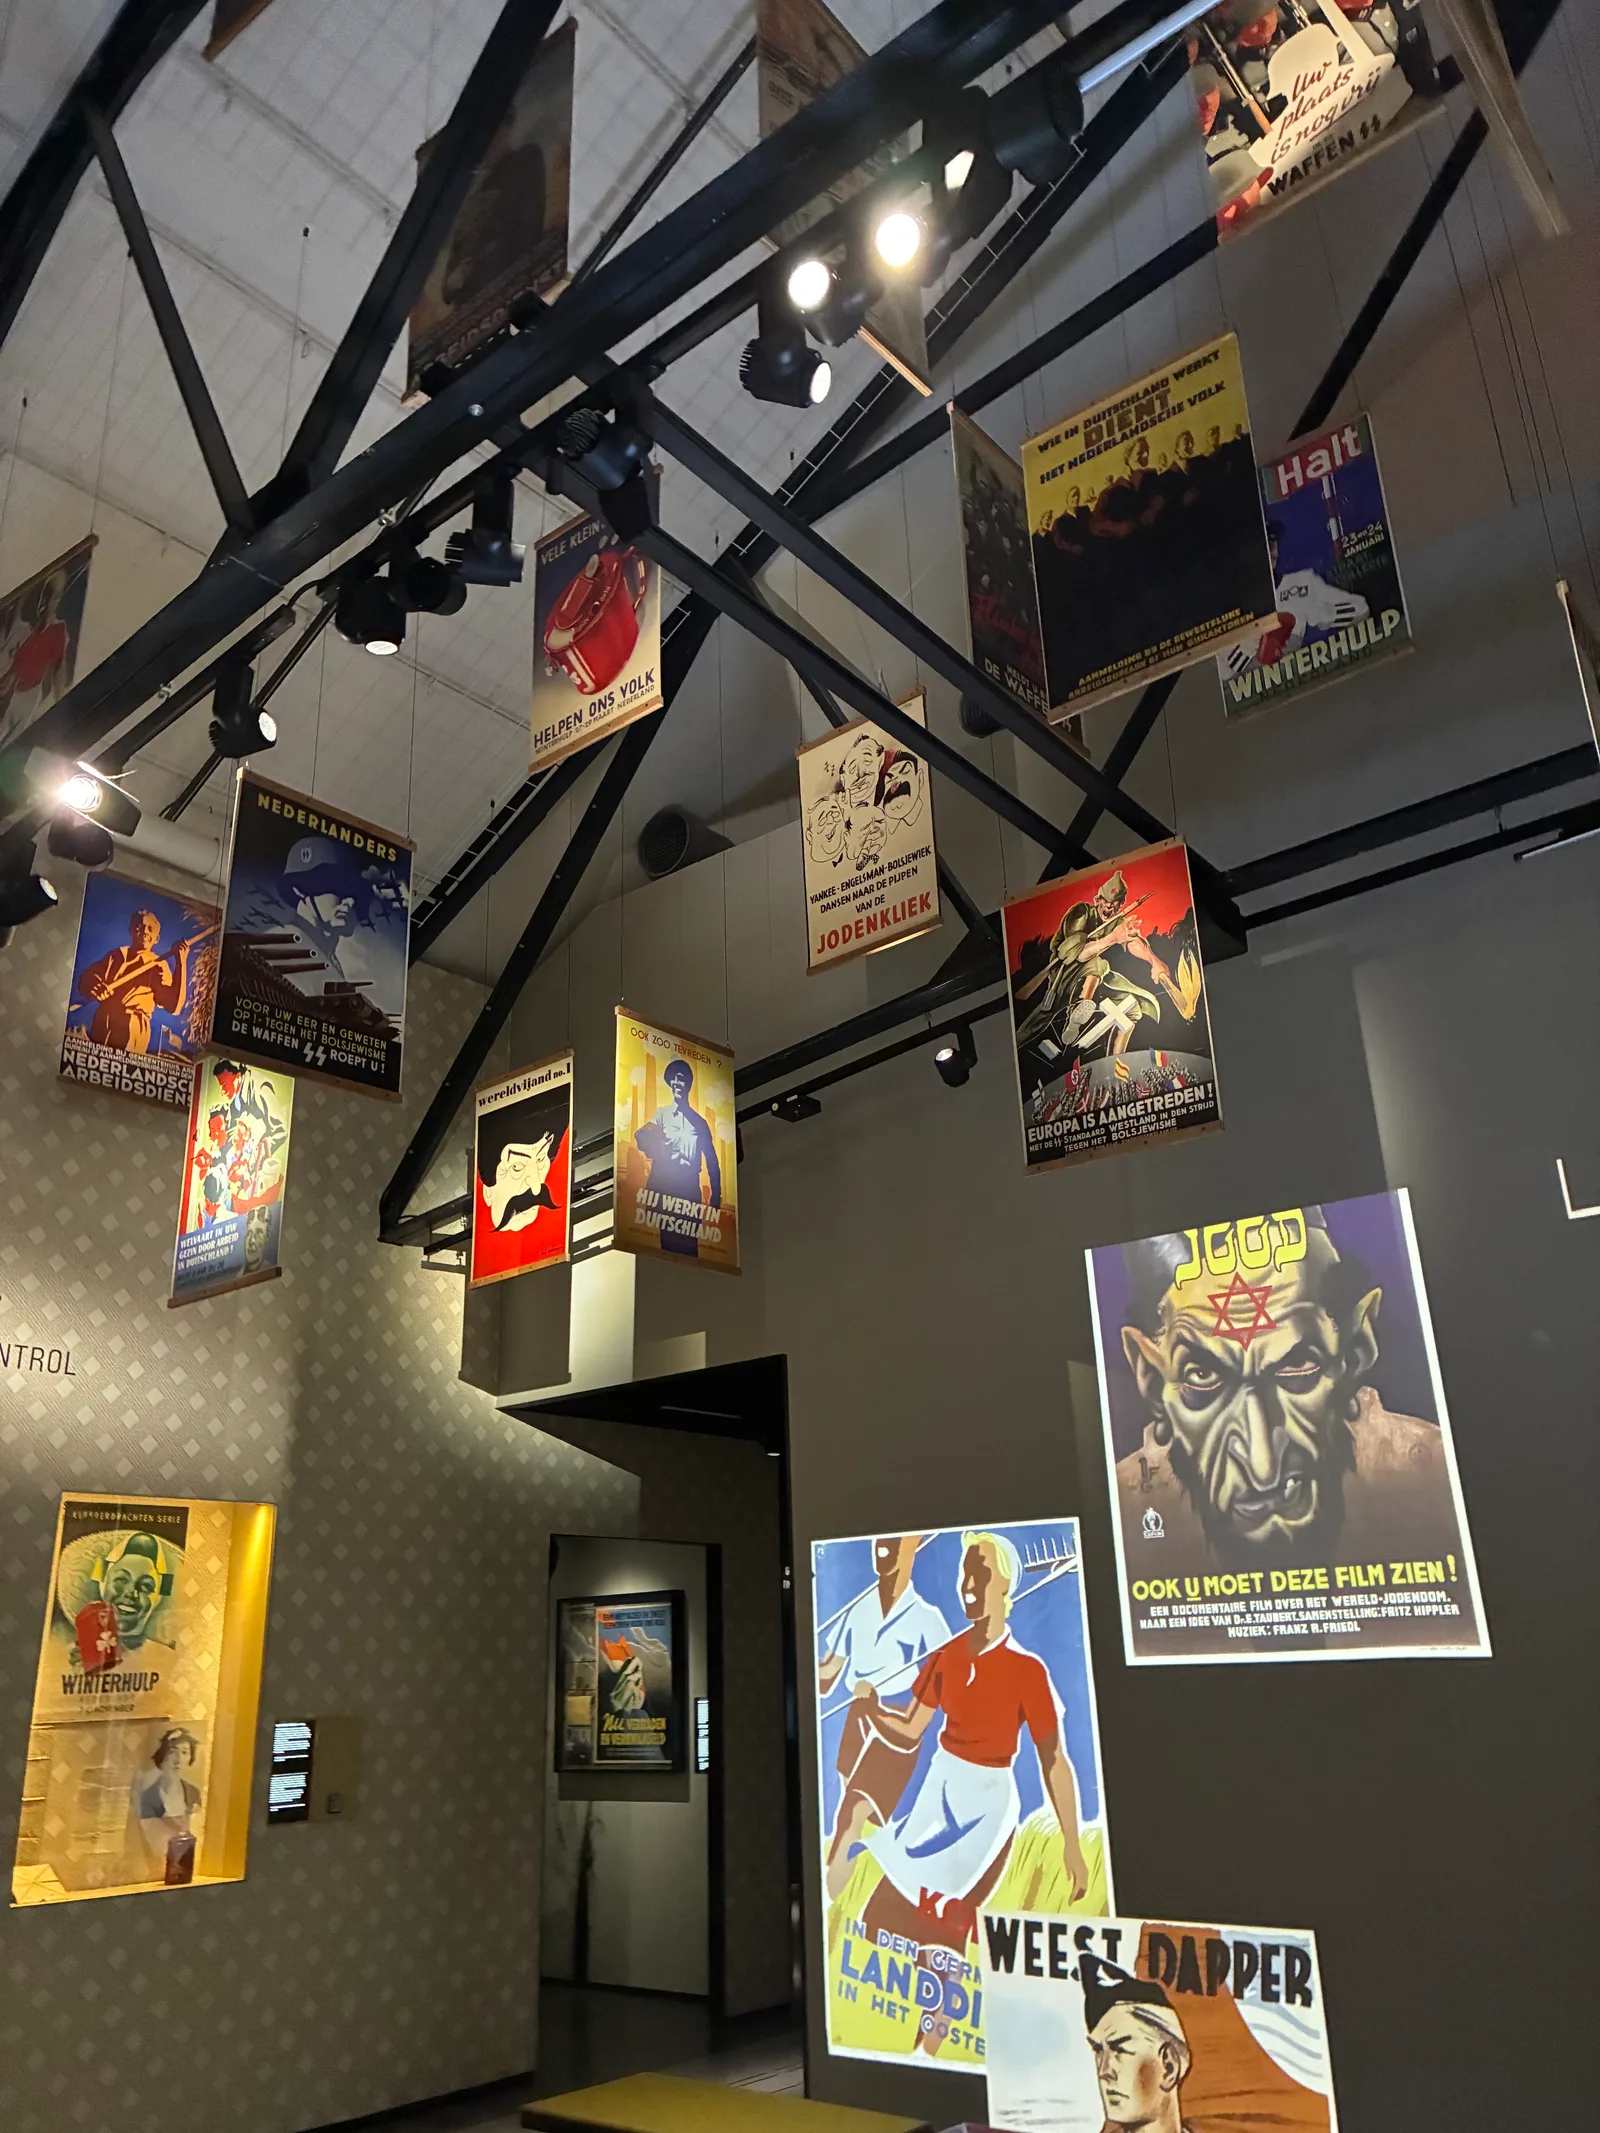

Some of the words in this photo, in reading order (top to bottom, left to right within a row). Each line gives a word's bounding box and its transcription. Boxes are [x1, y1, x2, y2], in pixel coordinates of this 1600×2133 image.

[1278, 67, 1354, 140] plaats
[1271, 141, 1290, 165] is
[1295, 109, 1336, 147] nog
[1267, 136, 1355, 196] WAFFEN
[1037, 433, 1062, 454] WIE
[1064, 424, 1079, 441] IN
[1083, 376, 1170, 428] DUITSCHLAND
[1172, 349, 1220, 382] WERKT
[1083, 388, 1171, 450] DIENT
[1039, 463, 1066, 485] HET
[1067, 400, 1186, 473] NEDERLANDSCHE
[1187, 380, 1226, 408] VOLK
[1276, 423, 1363, 495] Halt
[541, 539, 567, 567] VELE
[569, 520, 606, 550] KLEIN
[1341, 532, 1358, 548] 23
[1367, 520, 1384, 536] 24
[1344, 530, 1385, 558] JANUARI
[1078, 651, 1143, 687] AANMELDING
[1159, 638, 1172, 650] DE
[1228, 608, 1401, 702] WINTERHULP
[533, 709, 583, 748] HELPEN
[589, 691, 615, 718] ONS
[619, 668, 655, 699] VOLK
[984, 657, 1002, 681] DE
[1004, 671, 1050, 717] WAFFE
[535, 730, 573, 755] WINTERHULP
[593, 707, 615, 723] MAART
[617, 685, 655, 710] NEDERLAND
[257, 792, 397, 862] NEDERLANDERS
[820, 893, 851, 914] DANSEN
[852, 884, 875, 901] NAAR
[876, 878, 887, 891] DE
[889, 865, 918, 886] PIJPEN
[855, 899, 873, 914] VAN
[874, 894, 886, 907] DE
[816, 891, 932, 955] JODENKLIEK
[232, 1019, 249, 1035] DE
[252, 1025, 300, 1050] WAFFEN
[329, 1049, 366, 1071] ROEPT
[235, 996, 269, 1016] VOOR
[275, 1009, 291, 1022] UW
[297, 1015, 317, 1030] EER
[321, 1023, 335, 1035] EN
[339, 1028, 387, 1050] GEWETEN
[265, 1019, 296, 1035] TEGEN
[300, 1029, 317, 1041] HET
[321, 1034, 386, 1061] BOLSJEWISME
[65, 1036, 114, 1053] AANMELDING
[115, 1049, 127, 1059] BIJ
[630, 1027, 649, 1041] OOK
[652, 1035, 671, 1050] ZOO
[673, 1043, 712, 1066] TEVREDEN
[63, 1049, 192, 1093] NEDERLANDSC
[478, 1069, 552, 1107] wereldvijand
[1027, 1118, 1081, 1143] EUROPA
[1082, 1112, 1096, 1131] IS
[1029, 1143, 1043, 1153] MET
[1044, 1140, 1053, 1149] DE
[1109, 1114, 1157, 1132] WESTLAND
[1159, 1111, 1169, 1121] IN
[1170, 1107, 1187, 1118] DEN
[1189, 1100, 1215, 1114] STRIJD
[1064, 1140, 1089, 1153] TEGEN
[1091, 1136, 1107, 1149] HET
[1112, 1118, 1177, 1141] BOLSJEWISME
[635, 1208, 722, 1243] DUITSCHLAND
[636, 1188, 660, 1208] HIJ
[662, 1194, 706, 1220] WERKT
[704, 1206, 721, 1223] IN
[179, 1247, 197, 1260] GEZIN
[198, 1241, 216, 1252] DOOR
[216, 1232, 239, 1247] ARBEID
[180, 1230, 214, 1249] WELVAART
[215, 1228, 223, 1237] IN
[225, 1222, 238, 1233] UW
[177, 1261, 185, 1271] IN
[157, 1514, 181, 1524] SERIE
[1132, 1578, 1182, 1601] OOK
[1184, 1576, 1202, 1602] U
[1203, 1571, 1264, 1597] MOET
[1270, 1567, 1330, 1593] DEZE
[1334, 1563, 1386, 1589] FILM
[1139, 1619, 1167, 1629] NAAR
[1169, 1617, 1187, 1628] EEN
[1188, 1616, 1210, 1627] IDEE
[1211, 1614, 1232, 1626] VAN
[1414, 1604, 1460, 1616] HIPPLER
[1149, 1605, 1169, 1617] EEN
[1172, 1601, 1246, 1616] DOCUMENTAIRE
[1249, 1600, 1273, 1611] FILM
[1275, 1598, 1304, 1610] OVER
[1306, 1596, 1327, 1608] HET
[1228, 1625, 1272, 1638] MUZIEK:
[1273, 1624, 1309, 1636] FRANZ
[62, 1672, 160, 1695] WINTERHULP
[844, 1917, 867, 1939] IN
[877, 1928, 919, 1961] DEN
[984, 1915, 1123, 1982] WEEST
[1146, 1931, 1313, 2008] DAPPER
[837, 1979, 857, 2003] IN
[871, 1994, 911, 2024] HET
